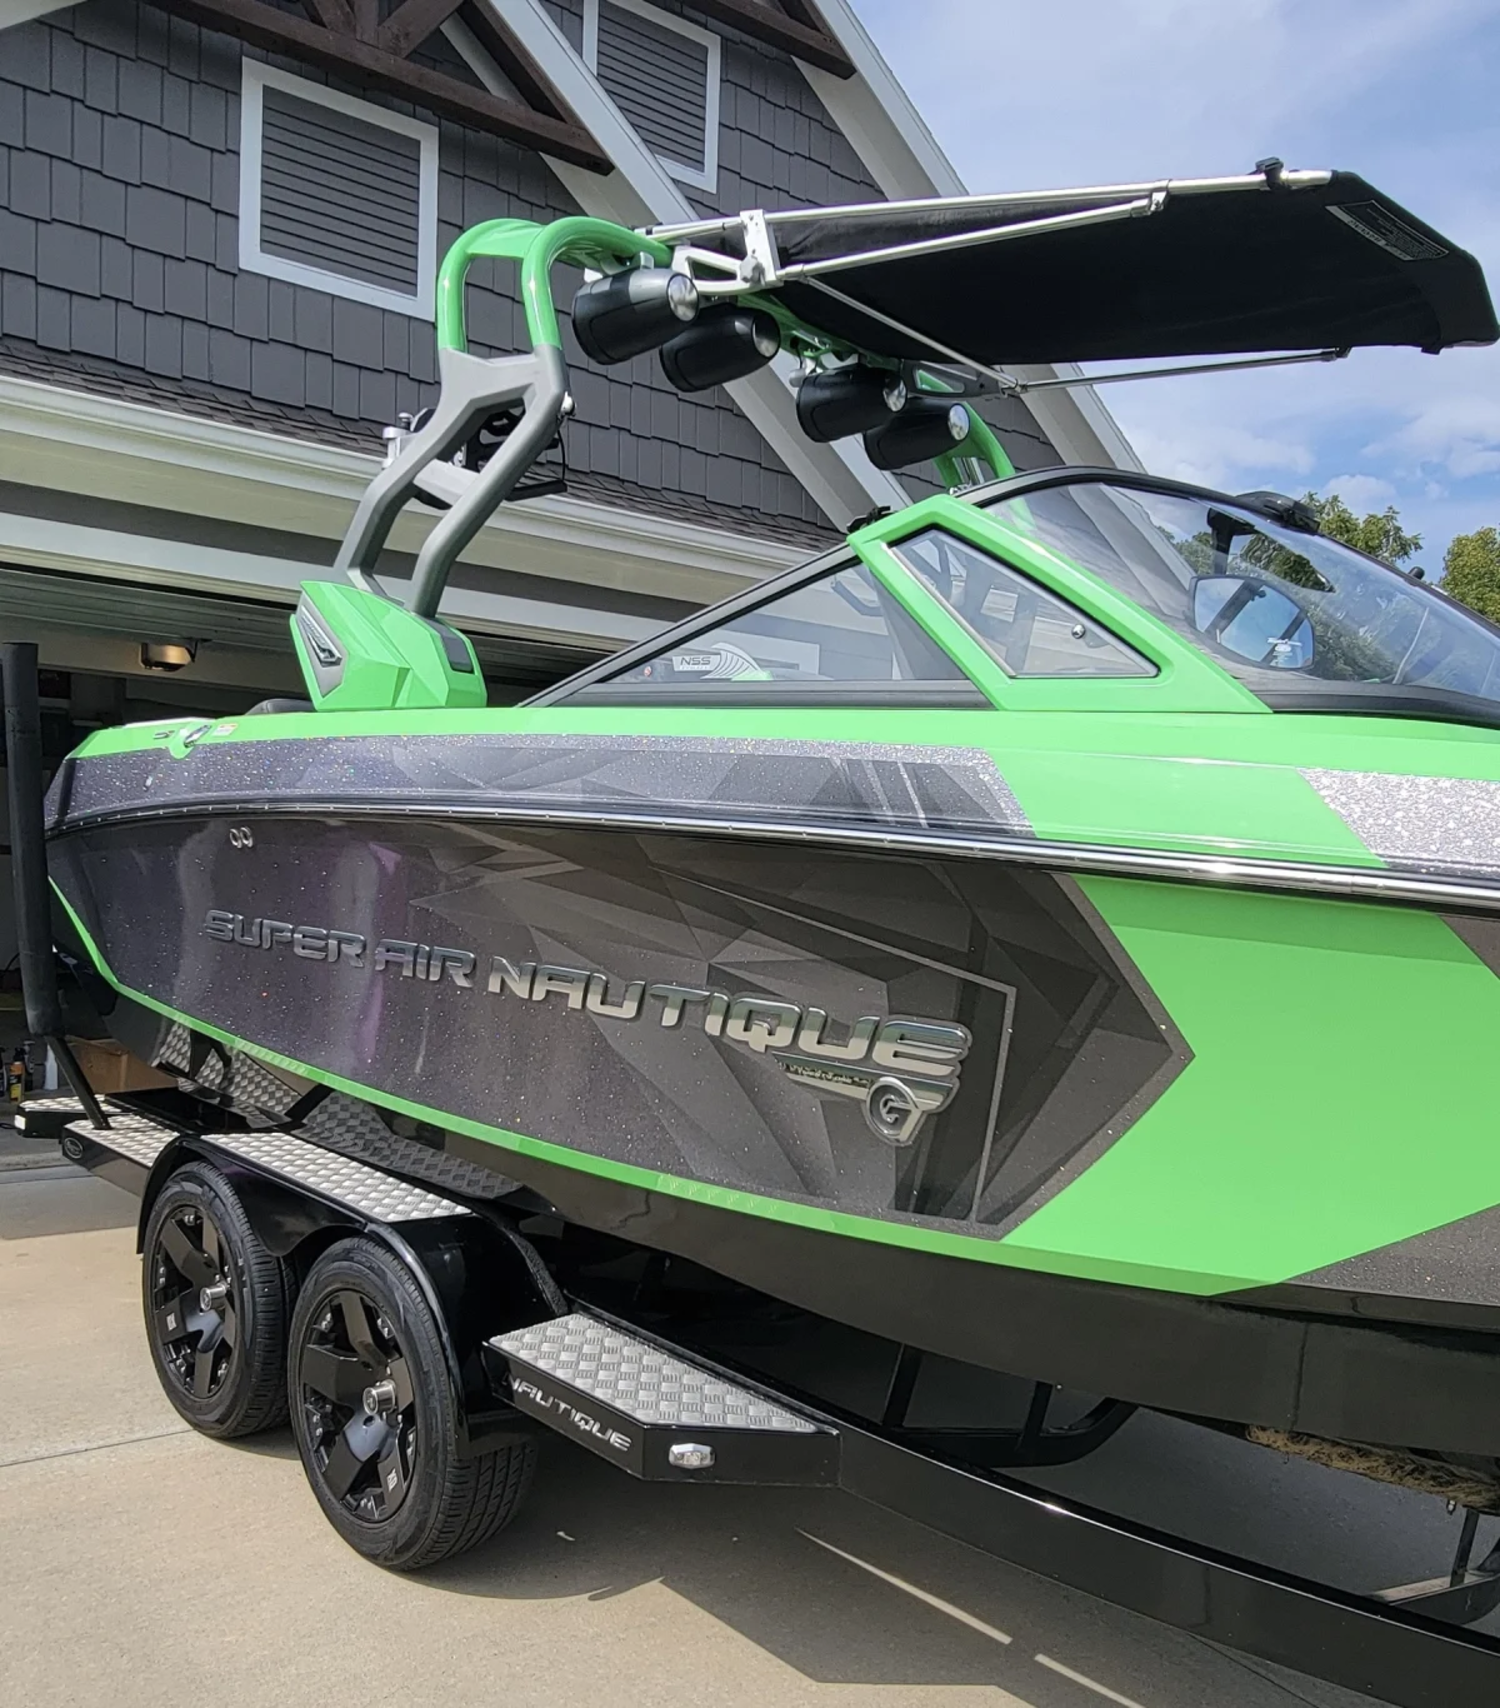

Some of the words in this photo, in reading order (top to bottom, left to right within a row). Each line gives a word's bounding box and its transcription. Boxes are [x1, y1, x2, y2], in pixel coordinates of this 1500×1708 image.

[680, 656, 711, 665] NSS
[204, 909, 367, 969] SUPER
[375, 937, 477, 989] AIR
[486, 954, 970, 1076] NAUTIQUE
